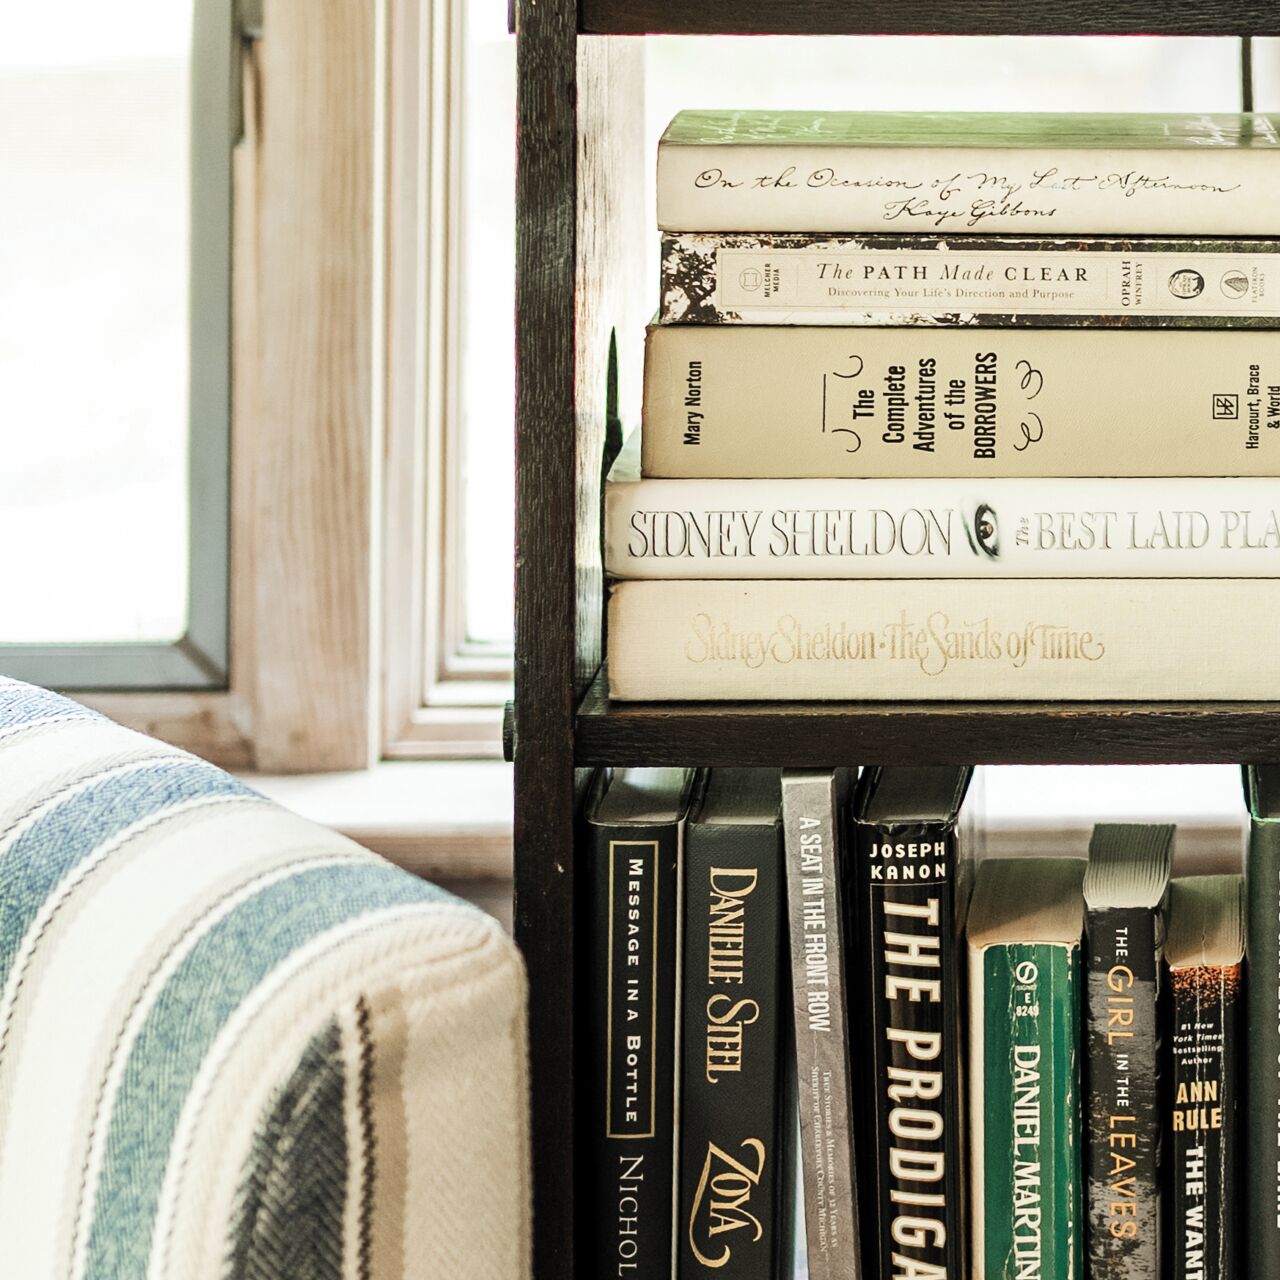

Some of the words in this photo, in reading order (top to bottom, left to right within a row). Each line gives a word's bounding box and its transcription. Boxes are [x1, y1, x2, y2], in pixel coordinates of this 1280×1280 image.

[694, 167, 744, 189] On
[754, 165, 798, 188] the
[806, 167, 923, 190] Occasion
[931, 173, 961, 201] of
[968, 172, 1022, 203] My
[1029, 166, 1098, 193] Last
[1099, 170, 1241, 198] Afternoon
[883, 196, 966, 227] Kaye
[967, 197, 1057, 228] Gibbons
[816, 263, 854, 280] The
[863, 265, 929, 280] PATH
[939, 264, 995, 281] Made
[1003, 267, 1090, 282] CLEAR
[1121, 260, 1132, 307] OPRAH
[828, 286, 892, 300] Discovering
[894, 287, 921, 299] Your
[922, 287, 952, 299] Life's
[955, 288, 1006, 300] Direction
[1008, 289, 1030, 300] and
[1032, 289, 1076, 301] Purpose
[684, 360, 702, 407] Norton
[945, 378, 966, 409] the
[853, 389, 875, 420] The
[882, 365, 911, 444] Complete
[913, 357, 937, 453] Adventures
[945, 411, 965, 431] of
[973, 351, 998, 460] BORROWERS
[683, 408, 704, 446] Mary
[627, 509, 764, 558] SIDNEY
[768, 507, 954, 557] SHELDON
[869, 841, 946, 859] JOSEPH
[870, 863, 947, 880] KANON
[627, 857, 645, 967] MESSAGE
[883, 898, 942, 1003] THE
[1115, 926, 1129, 958] THE
[627, 978, 639, 1002] IN
[1107, 964, 1135, 1046] GIRL
[626, 1009, 640, 1021] A
[625, 1035, 642, 1123] BOTTLE
[1115, 1054, 1129, 1071] IN
[1012, 1044, 1041, 1157] DANIEL
[1115, 1077, 1130, 1108] THE
[1175, 1080, 1218, 1105] ANN
[1172, 1107, 1222, 1132] RULE
[1108, 1115, 1138, 1240] LEAVES
[1186, 1145, 1205, 1197] THE
